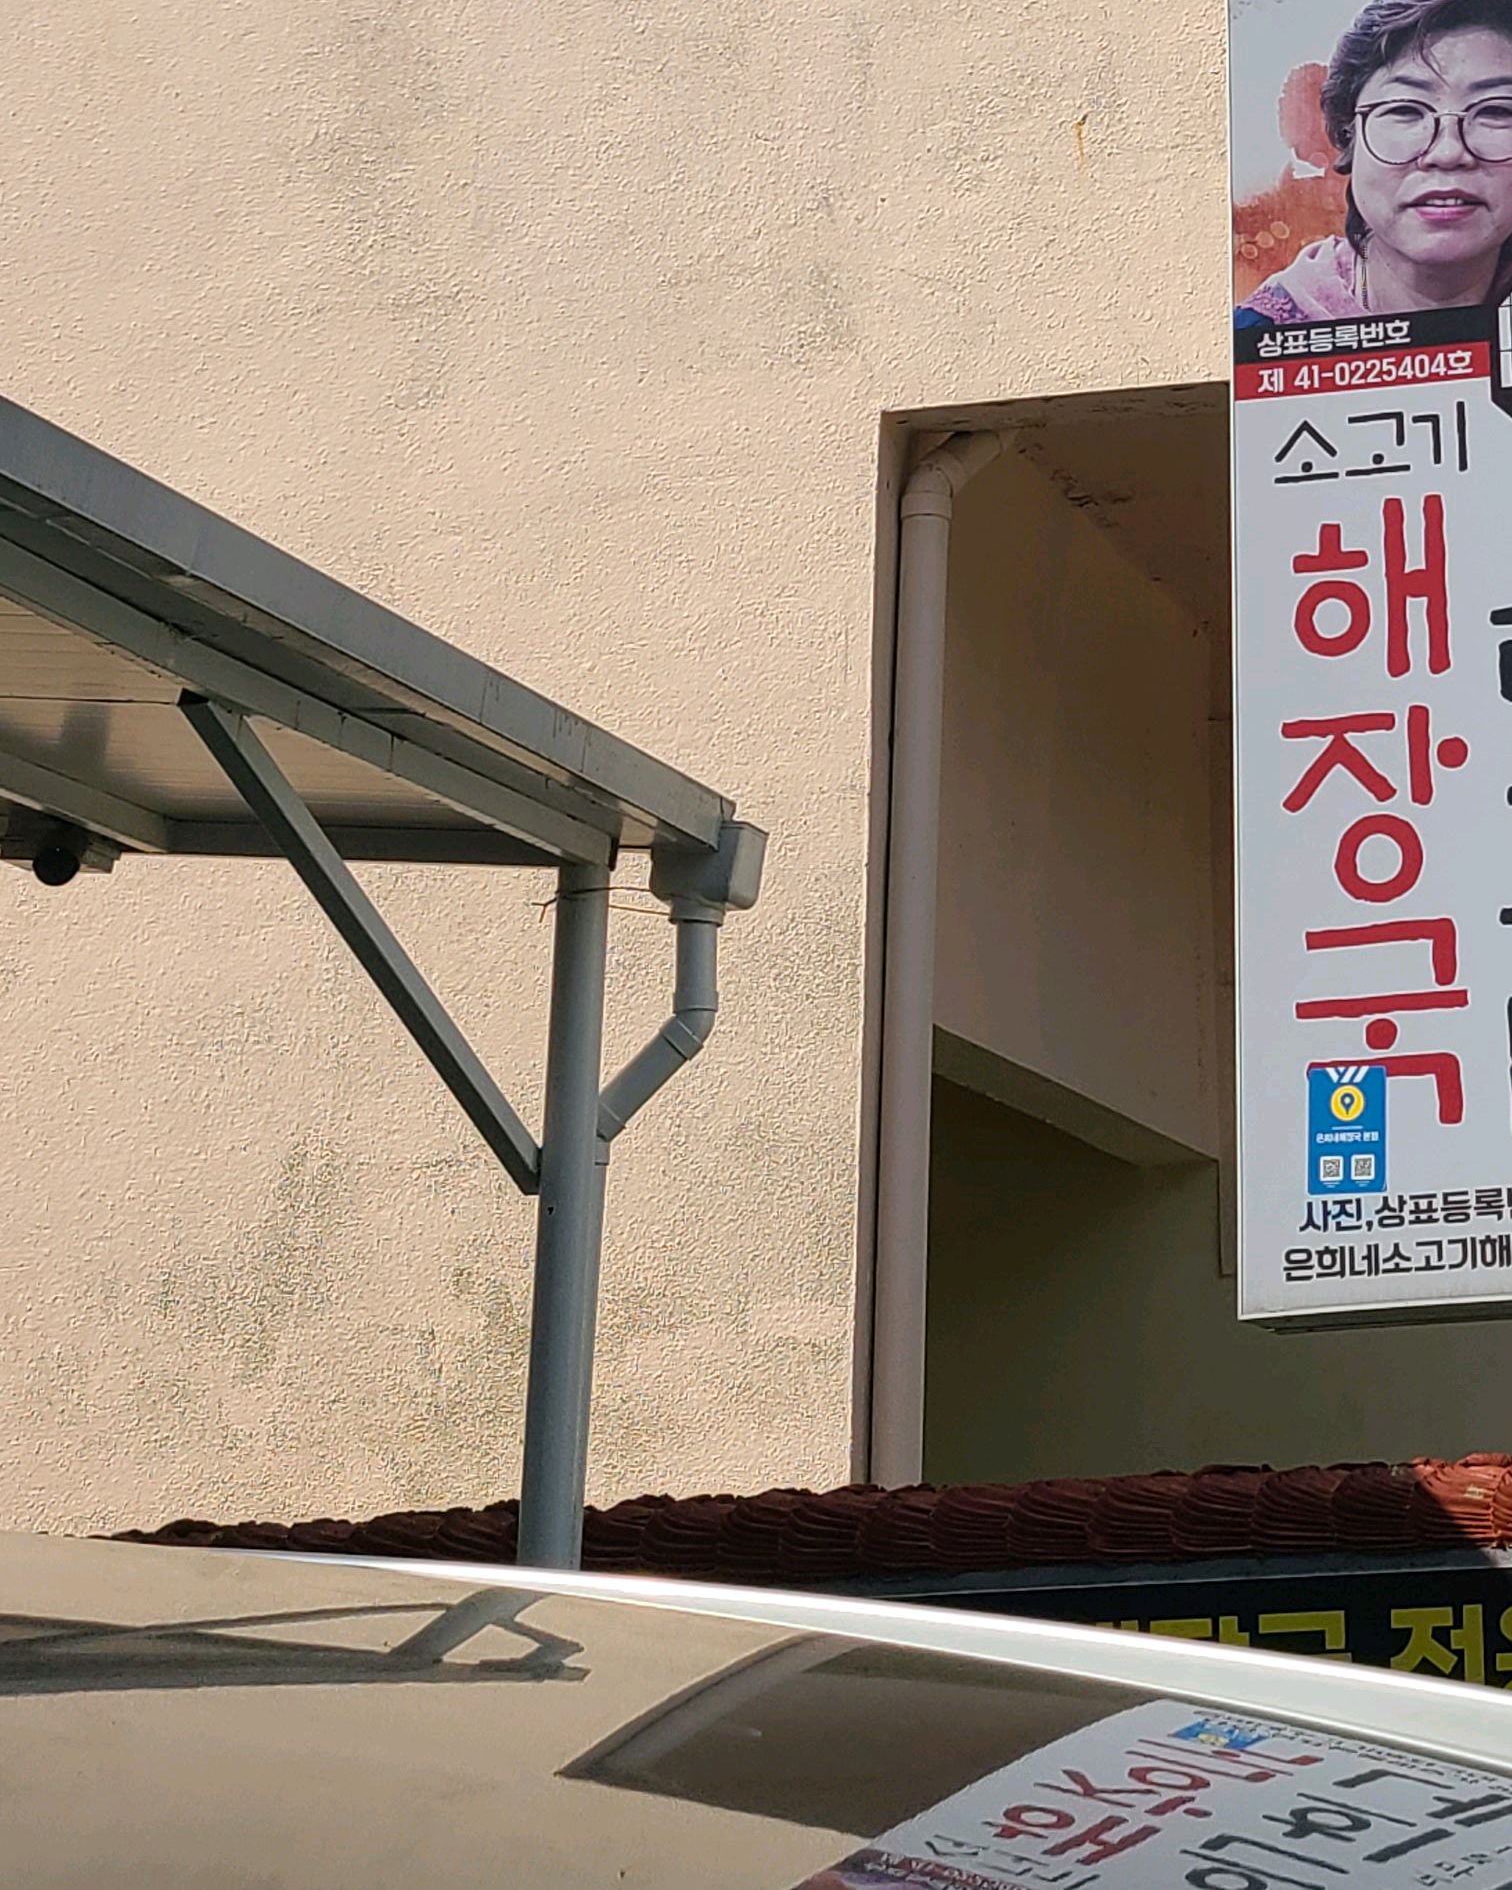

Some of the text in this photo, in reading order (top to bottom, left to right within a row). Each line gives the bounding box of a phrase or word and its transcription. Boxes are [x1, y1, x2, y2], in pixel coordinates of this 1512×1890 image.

[1257, 319, 1411, 358] 상표등록번호
[1257, 349, 1474, 394] 제 41-0225404호
[1273, 399, 1469, 484] 소고기
[1281, 494, 1470, 1125] 해장국
